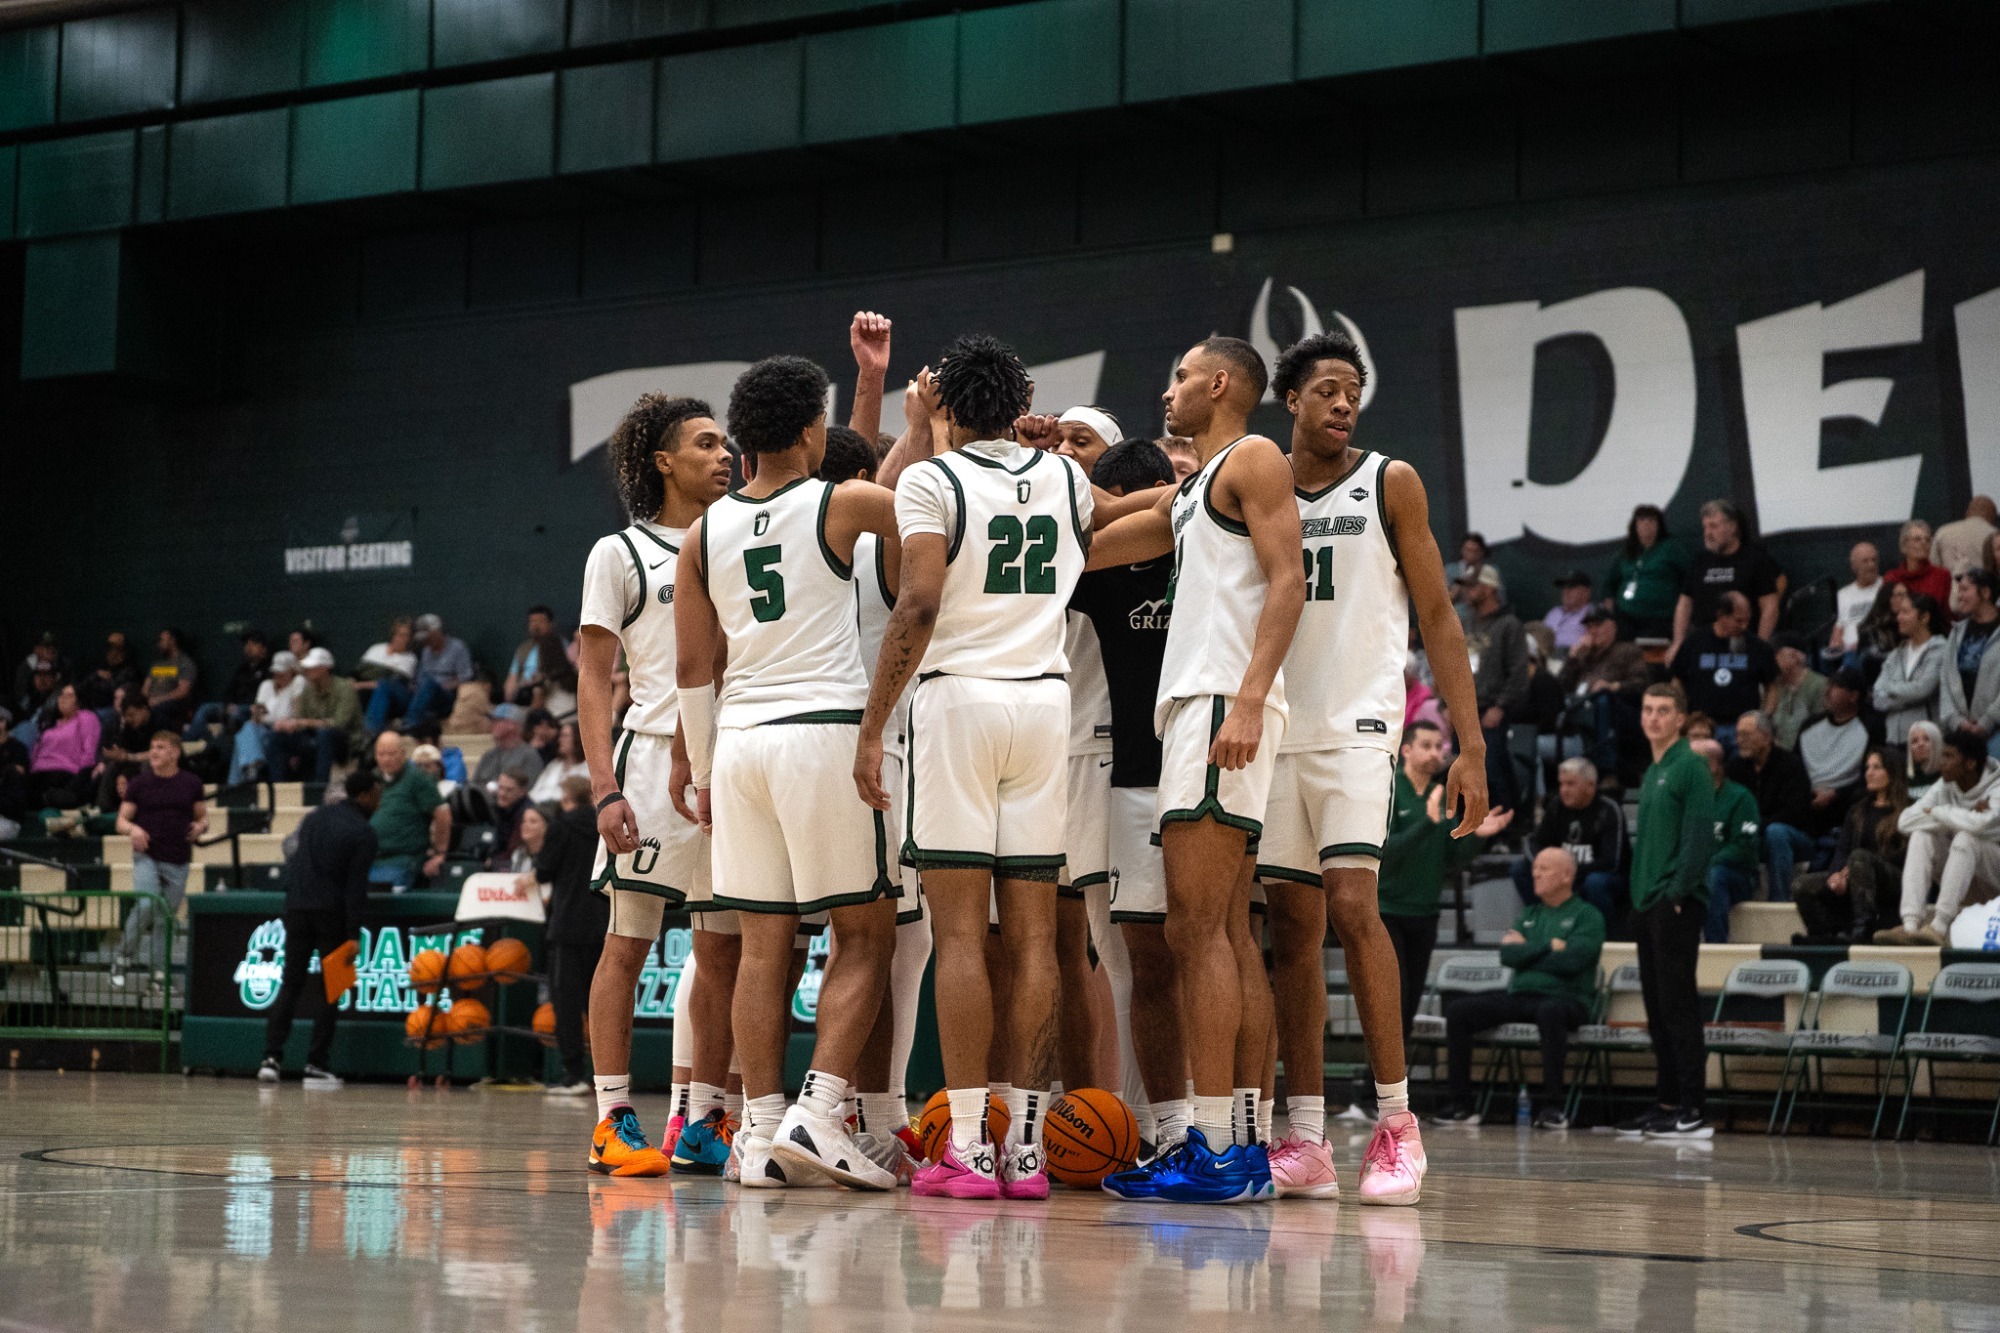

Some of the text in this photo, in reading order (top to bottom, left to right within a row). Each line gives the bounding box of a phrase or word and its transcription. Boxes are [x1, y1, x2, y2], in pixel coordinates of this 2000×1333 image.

[1301, 516, 1367, 539] ZZLIES
[284, 540, 413, 575] VISITOR SEATING
[983, 515, 1058, 594] 22
[743, 544, 786, 623] 5
[1376, 722, 1385, 730] XL
[1737, 970, 1799, 985] GRIZZLIES
[1834, 973, 1899, 987] GRIZZLIES
[1049, 1097, 1095, 1140] Wilson
